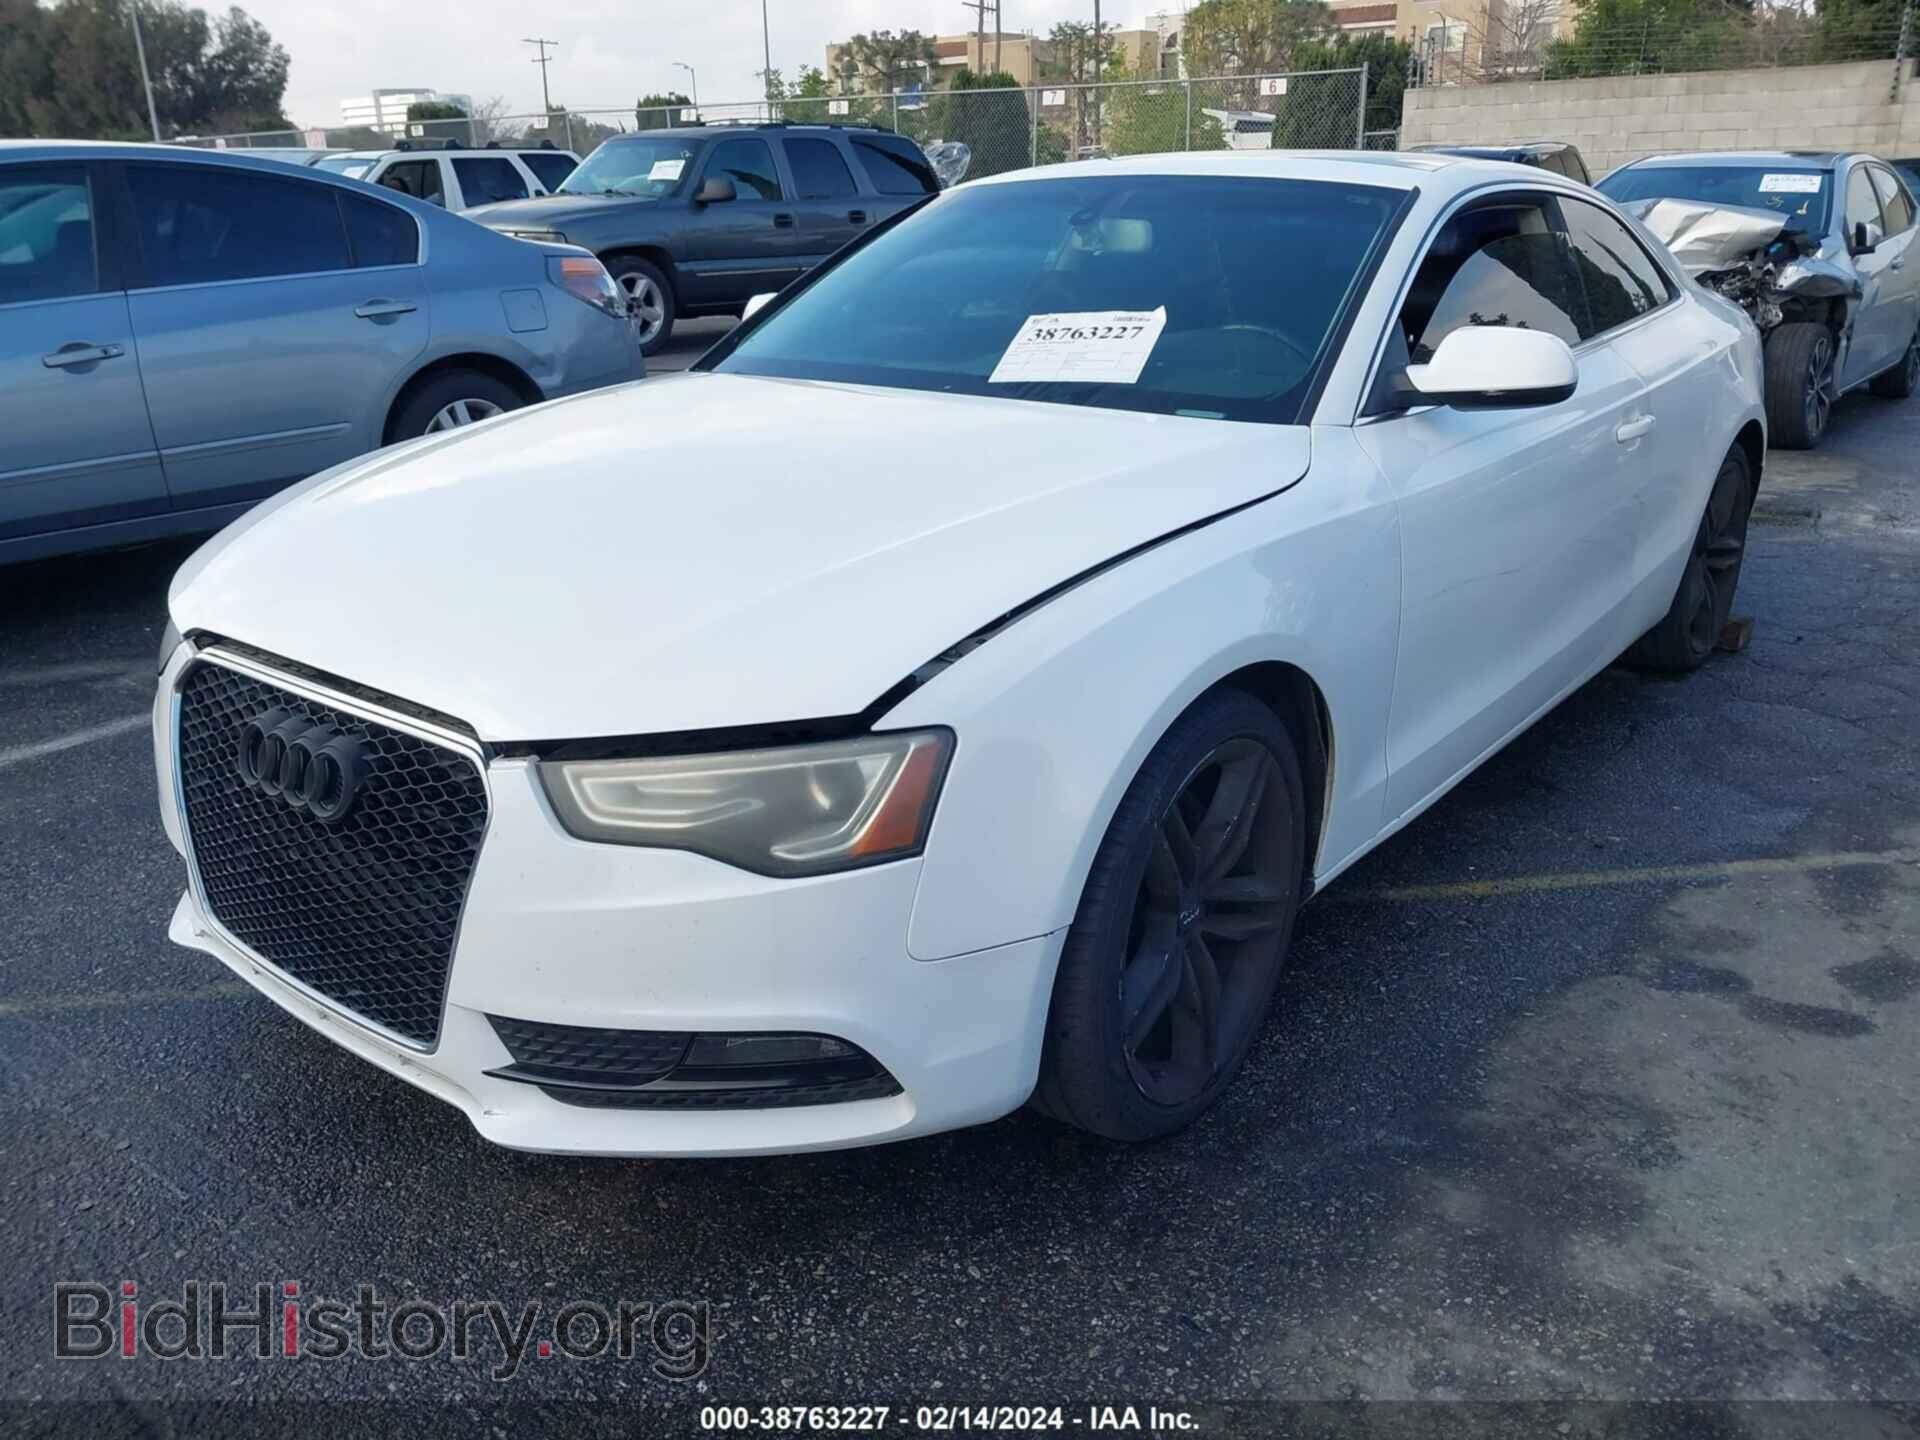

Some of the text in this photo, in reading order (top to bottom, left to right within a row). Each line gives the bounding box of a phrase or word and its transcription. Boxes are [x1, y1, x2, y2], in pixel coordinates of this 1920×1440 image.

[1268, 79, 1278, 94] 6
[1048, 90, 1057, 104] 7
[1027, 325, 1145, 341] 38763227
